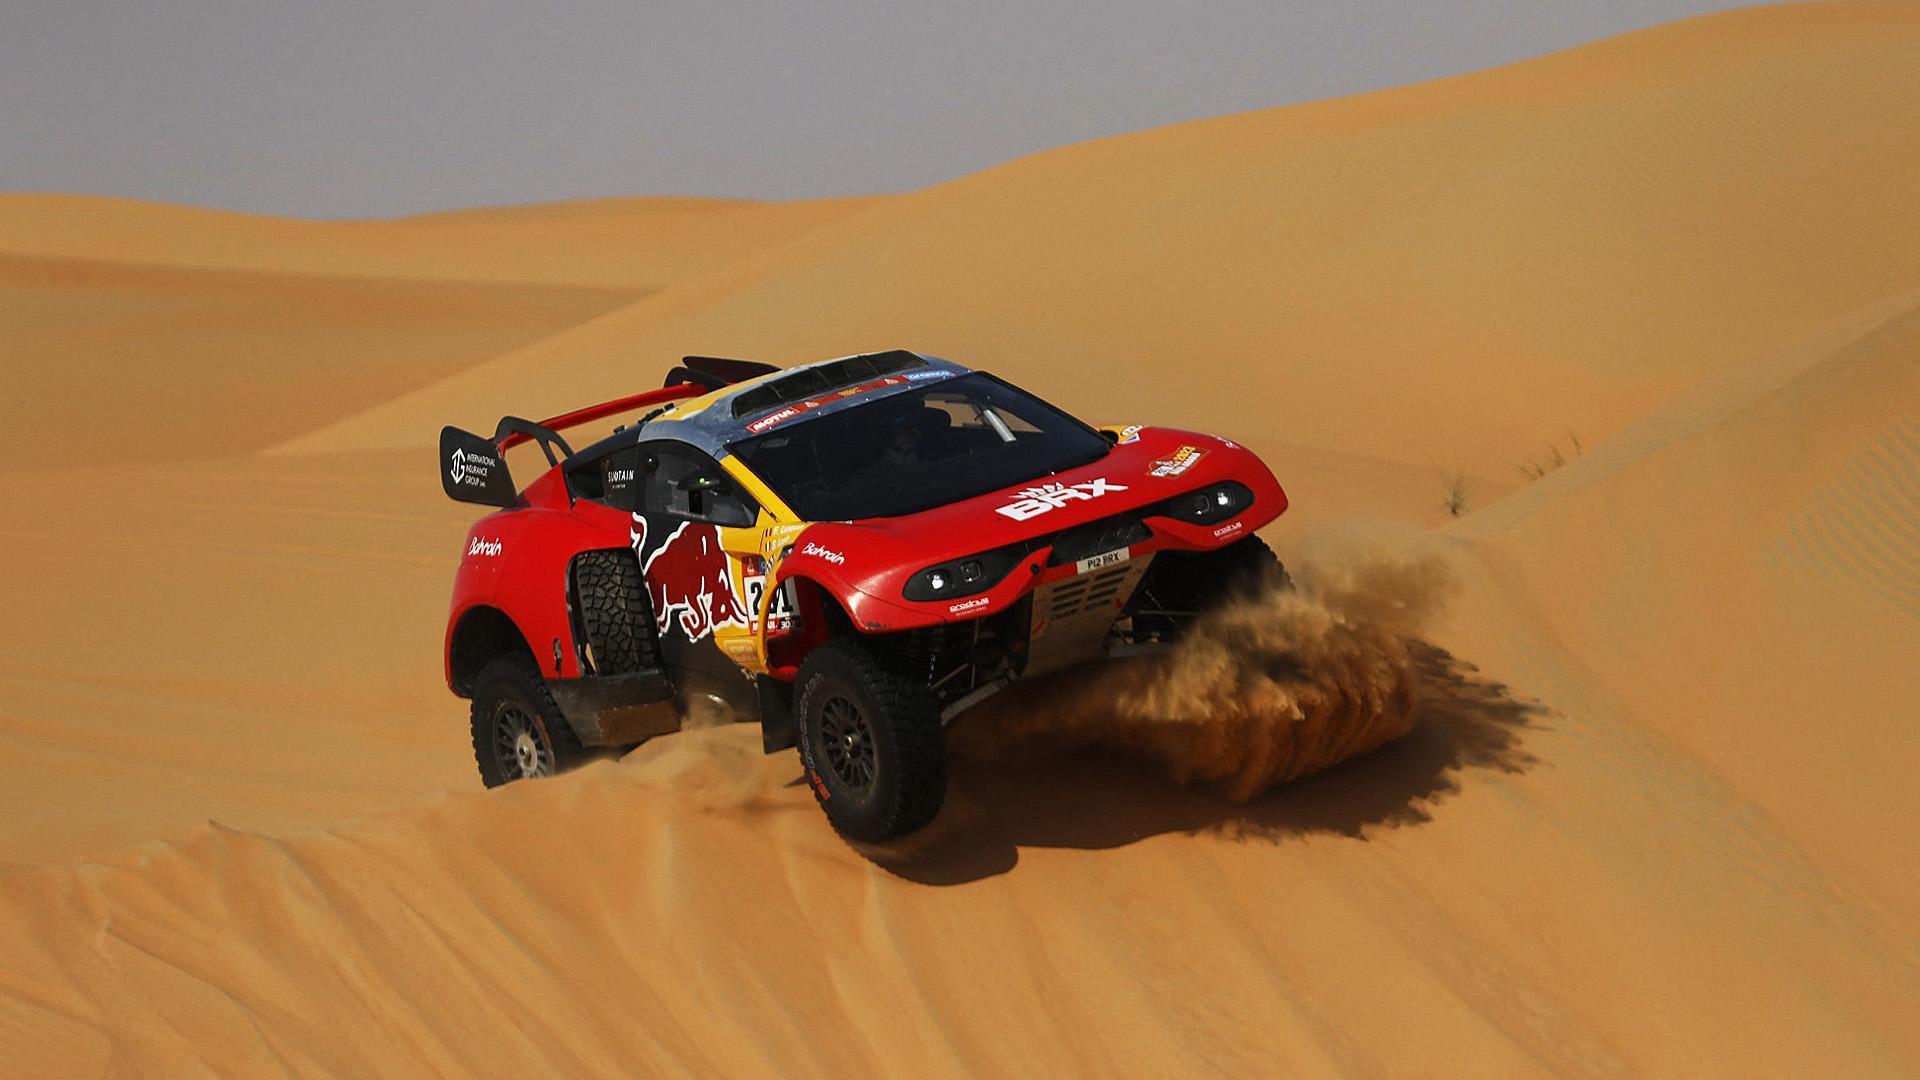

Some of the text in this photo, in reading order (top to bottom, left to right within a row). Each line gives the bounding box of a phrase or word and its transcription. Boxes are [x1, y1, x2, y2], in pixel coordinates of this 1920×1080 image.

[753, 409, 796, 430] MOTUL
[994, 477, 1129, 521] BRX
[467, 536, 502, 557] Bahrain
[801, 541, 845, 565] Bahrain
